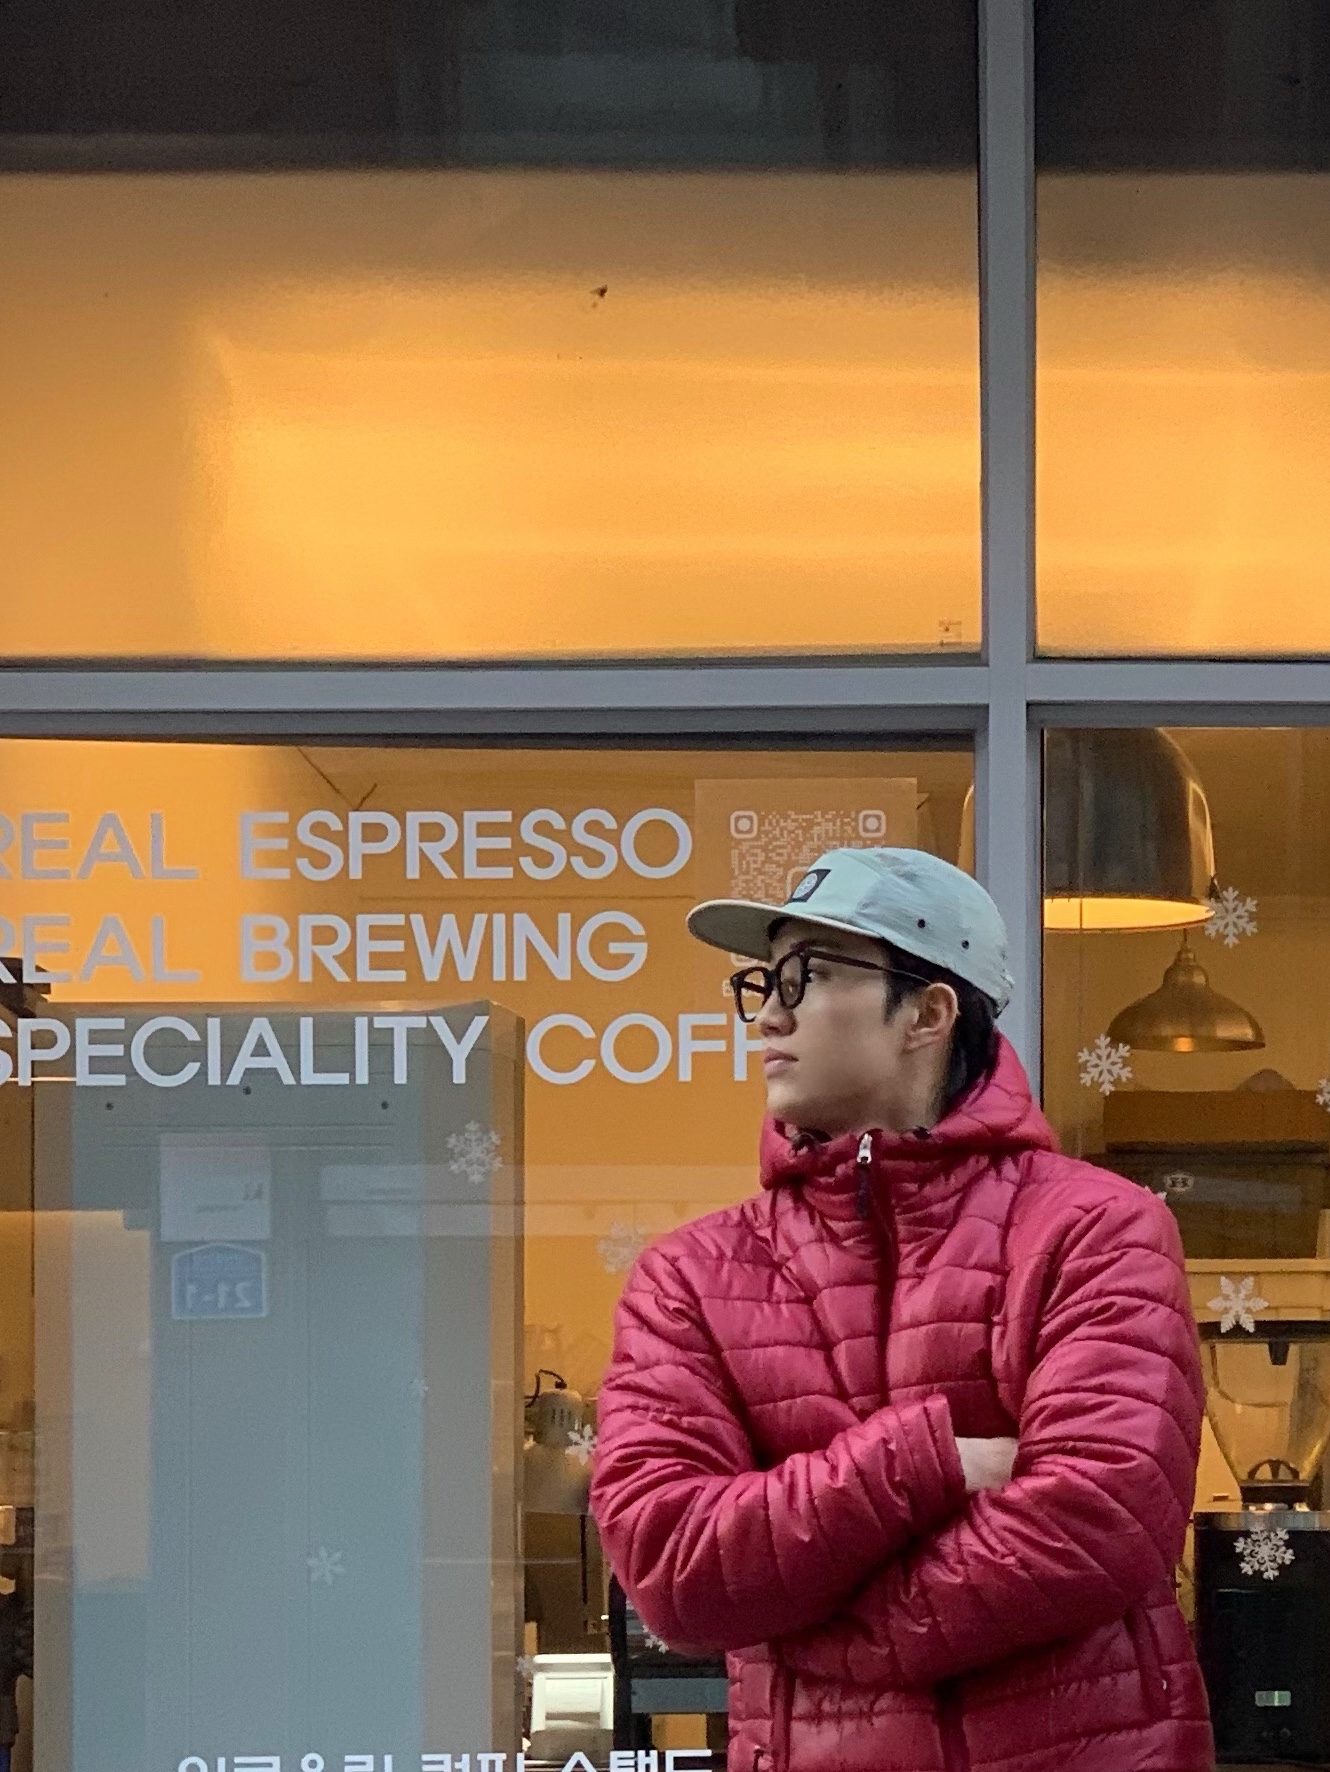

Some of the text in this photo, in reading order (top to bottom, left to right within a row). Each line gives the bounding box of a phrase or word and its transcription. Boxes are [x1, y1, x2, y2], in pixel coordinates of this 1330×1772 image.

[0, 808, 694, 881] EAL ESPRESSO
[240, 910, 648, 983] BREWING
[0, 1014, 489, 1088] PECIALITY
